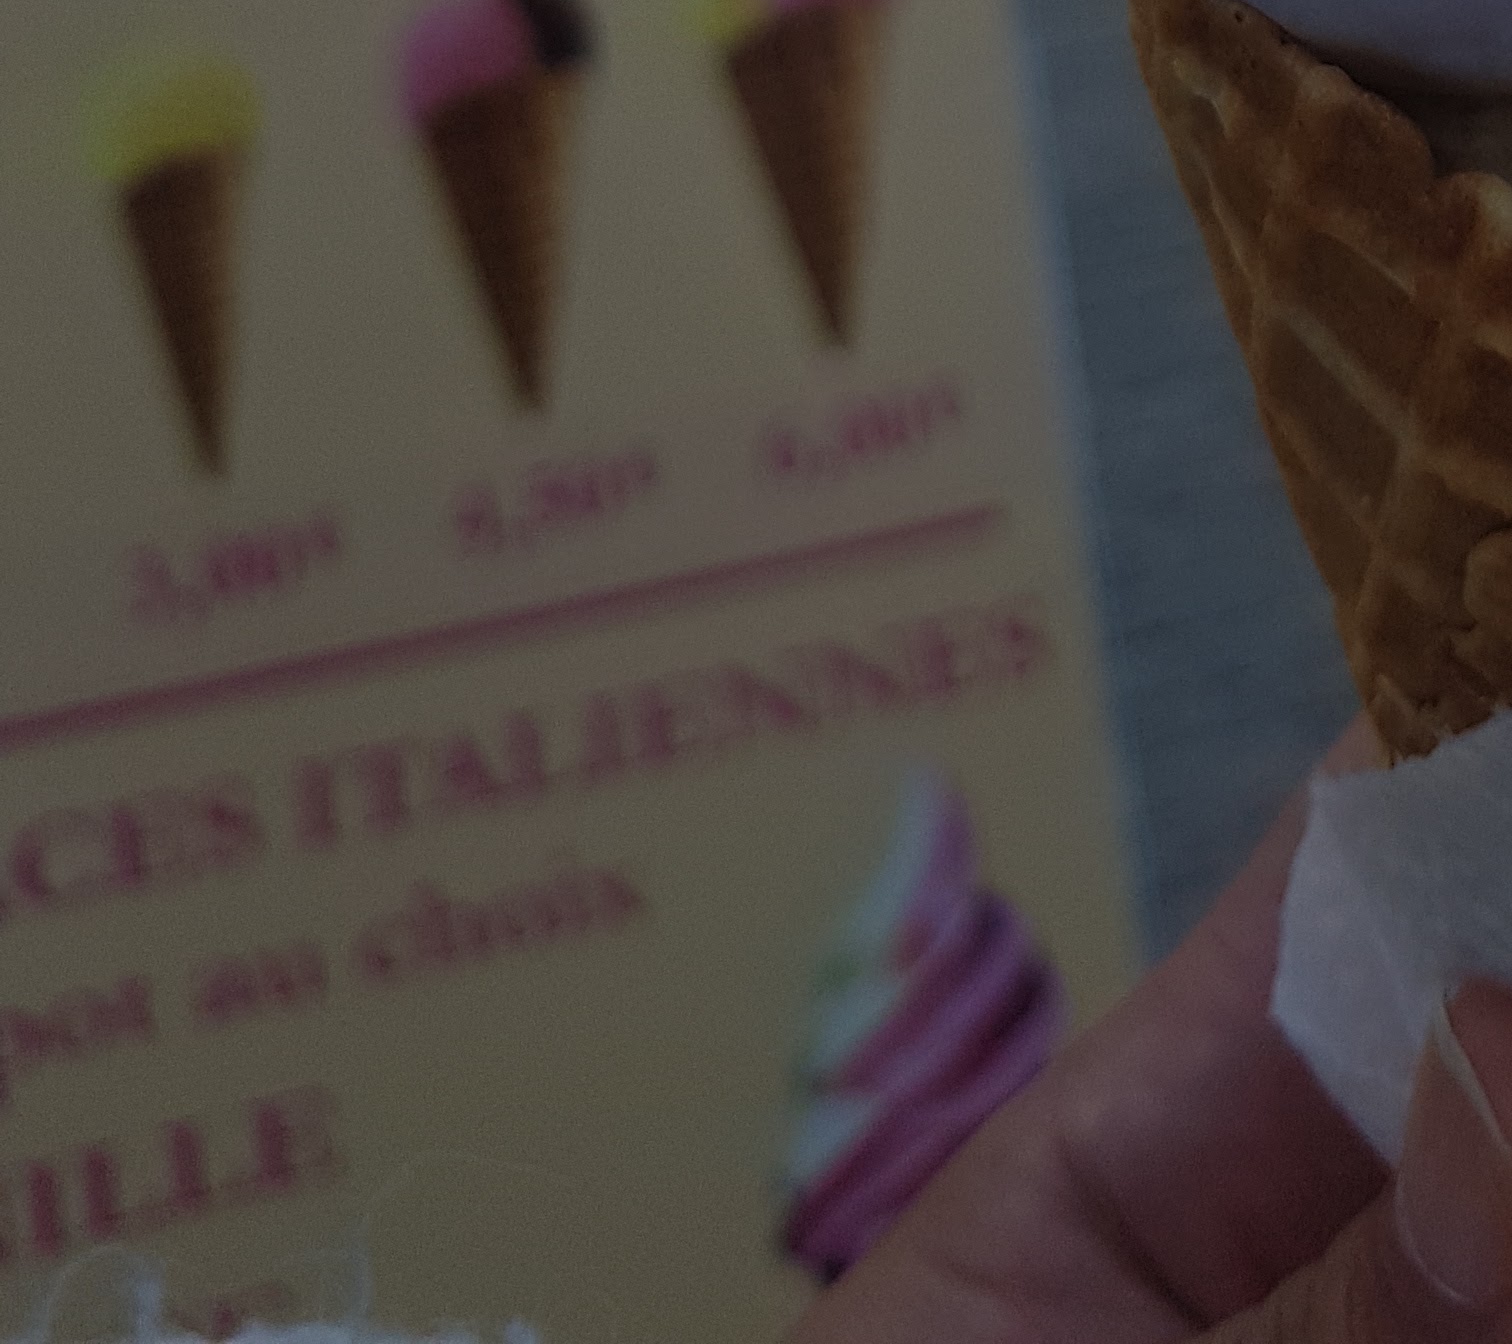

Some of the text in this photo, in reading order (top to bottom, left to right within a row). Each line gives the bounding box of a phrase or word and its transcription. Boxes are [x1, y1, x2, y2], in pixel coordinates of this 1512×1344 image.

[0, 594, 1056, 924] CES ITALIENNES
[0, 1088, 346, 1264] ILLE
